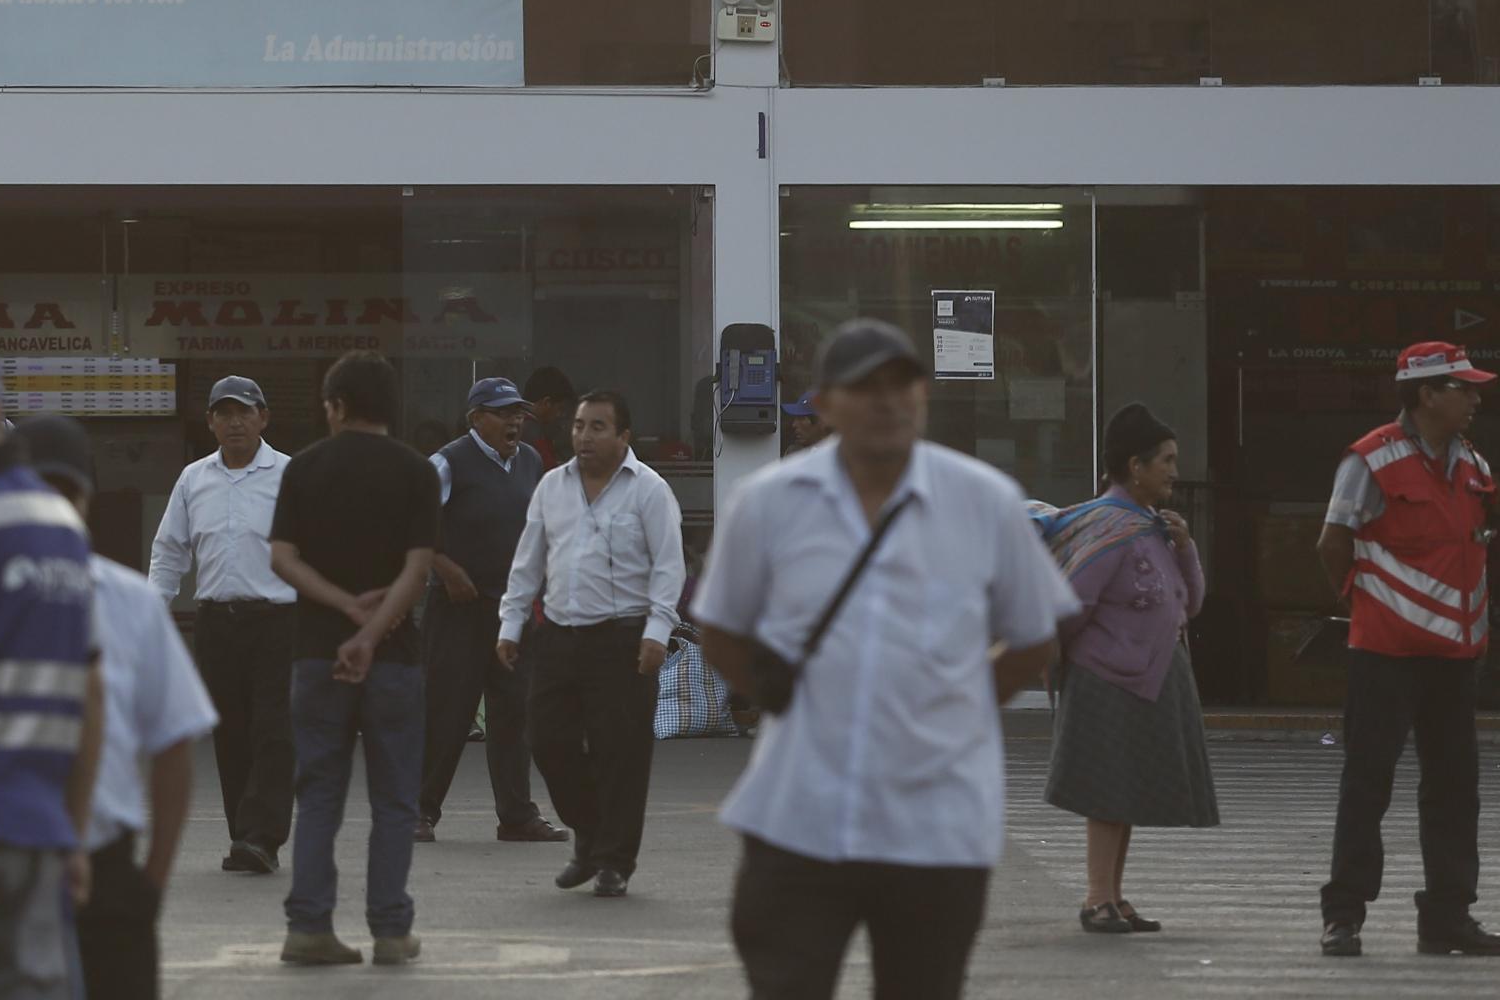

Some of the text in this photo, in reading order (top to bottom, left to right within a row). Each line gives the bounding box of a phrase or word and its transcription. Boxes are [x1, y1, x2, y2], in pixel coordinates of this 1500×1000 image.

[263, 34, 515, 61] La Administración
[810, 236, 1024, 274] COMIENDAS
[154, 280, 251, 296] EXPRESO
[144, 299, 499, 326] MOLINA
[177, 336, 244, 350] TARMA
[267, 336, 380, 350] LA MERCED
